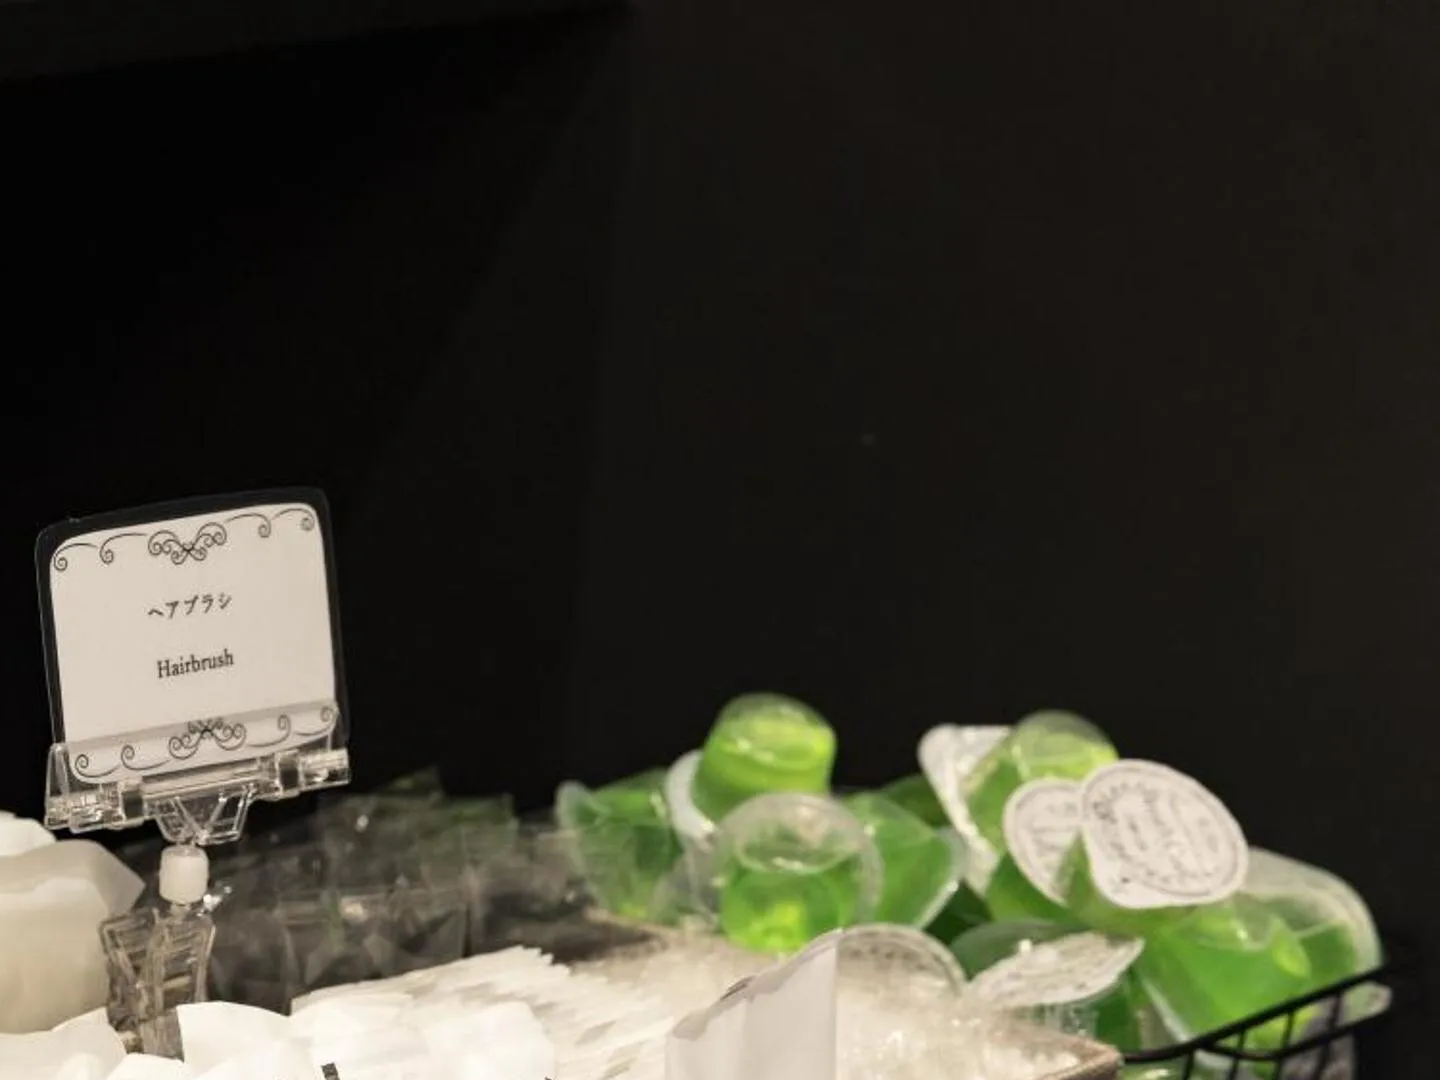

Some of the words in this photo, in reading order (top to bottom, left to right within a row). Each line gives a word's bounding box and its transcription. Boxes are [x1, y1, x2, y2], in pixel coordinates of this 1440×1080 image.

[148, 593, 232, 619] ヘアブラシ
[157, 649, 234, 678] Hairbrush
